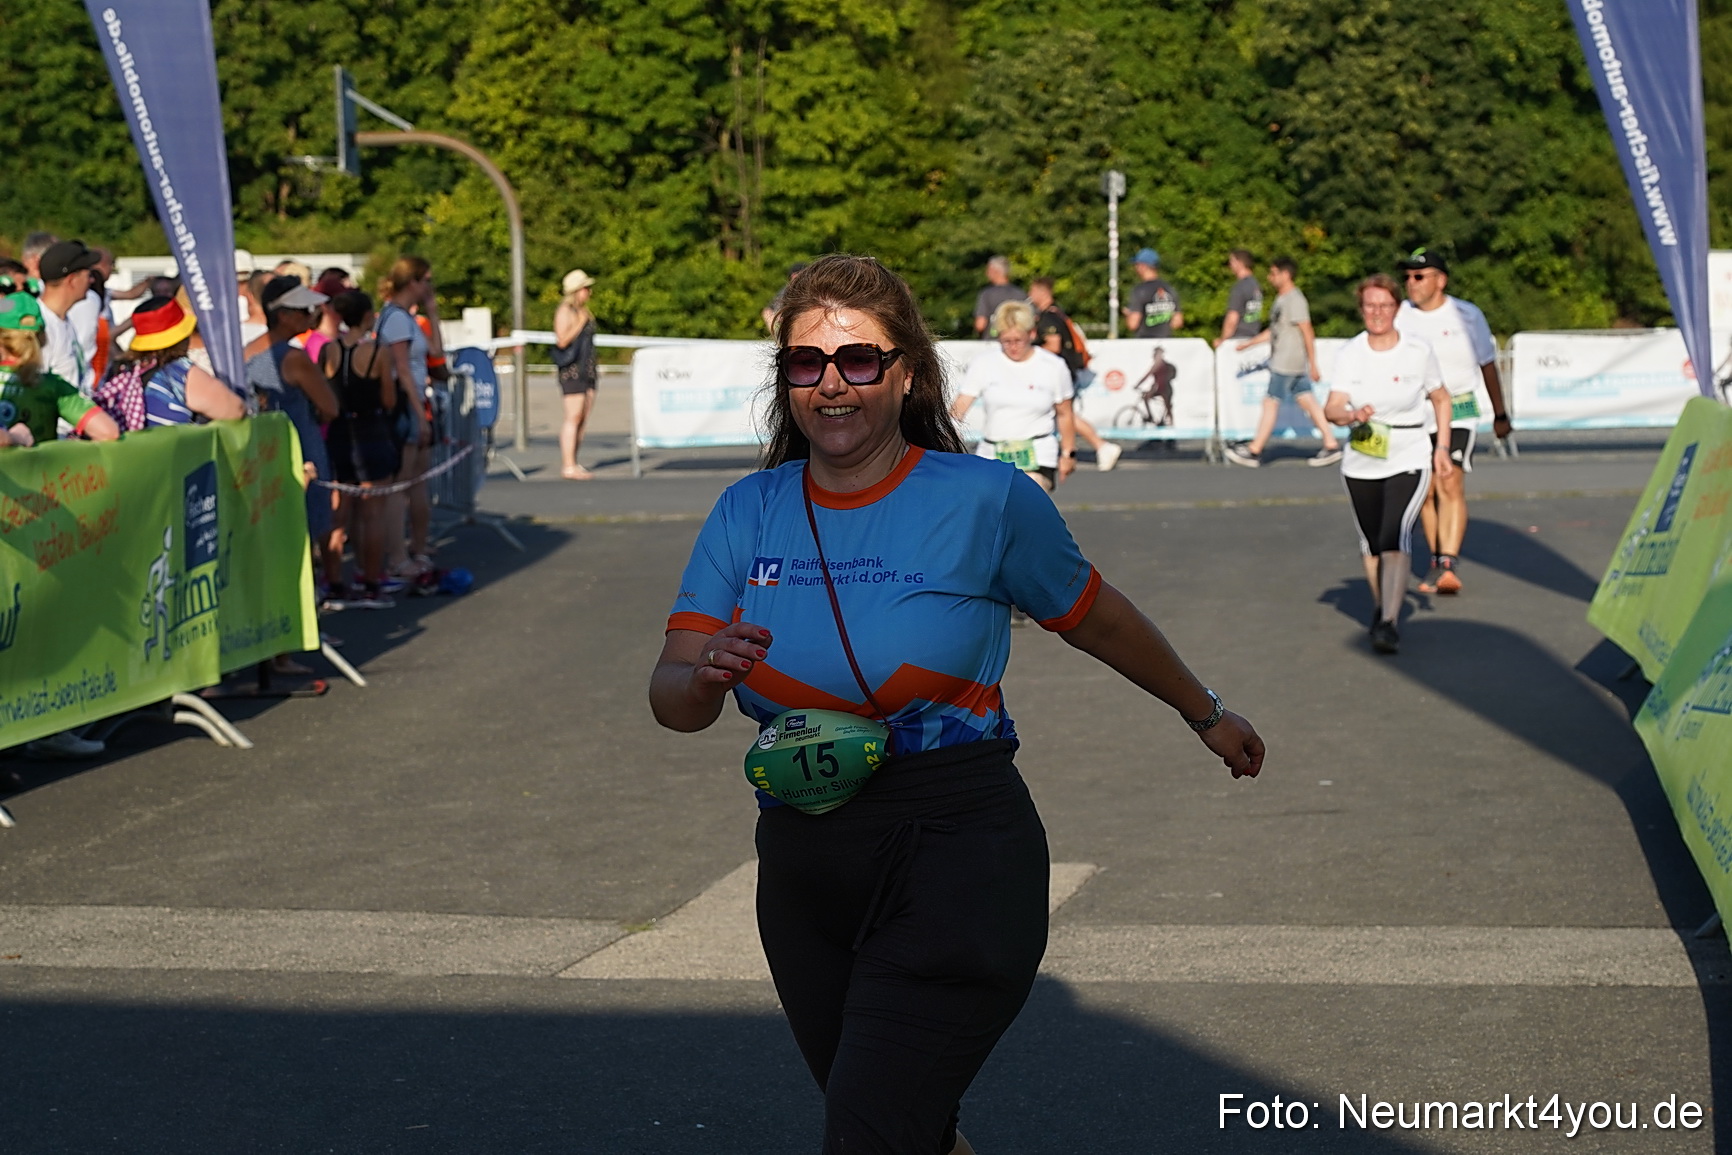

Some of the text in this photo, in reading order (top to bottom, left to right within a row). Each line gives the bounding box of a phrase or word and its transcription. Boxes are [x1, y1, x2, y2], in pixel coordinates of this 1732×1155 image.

[787, 573, 850, 586] Neumrkt
[903, 572, 924, 584] eG
[778, 724, 822, 741] Firmenlauf
[795, 732, 820, 743] neumarkt
[791, 741, 840, 782] 15
[781, 784, 829, 800] Hunner
